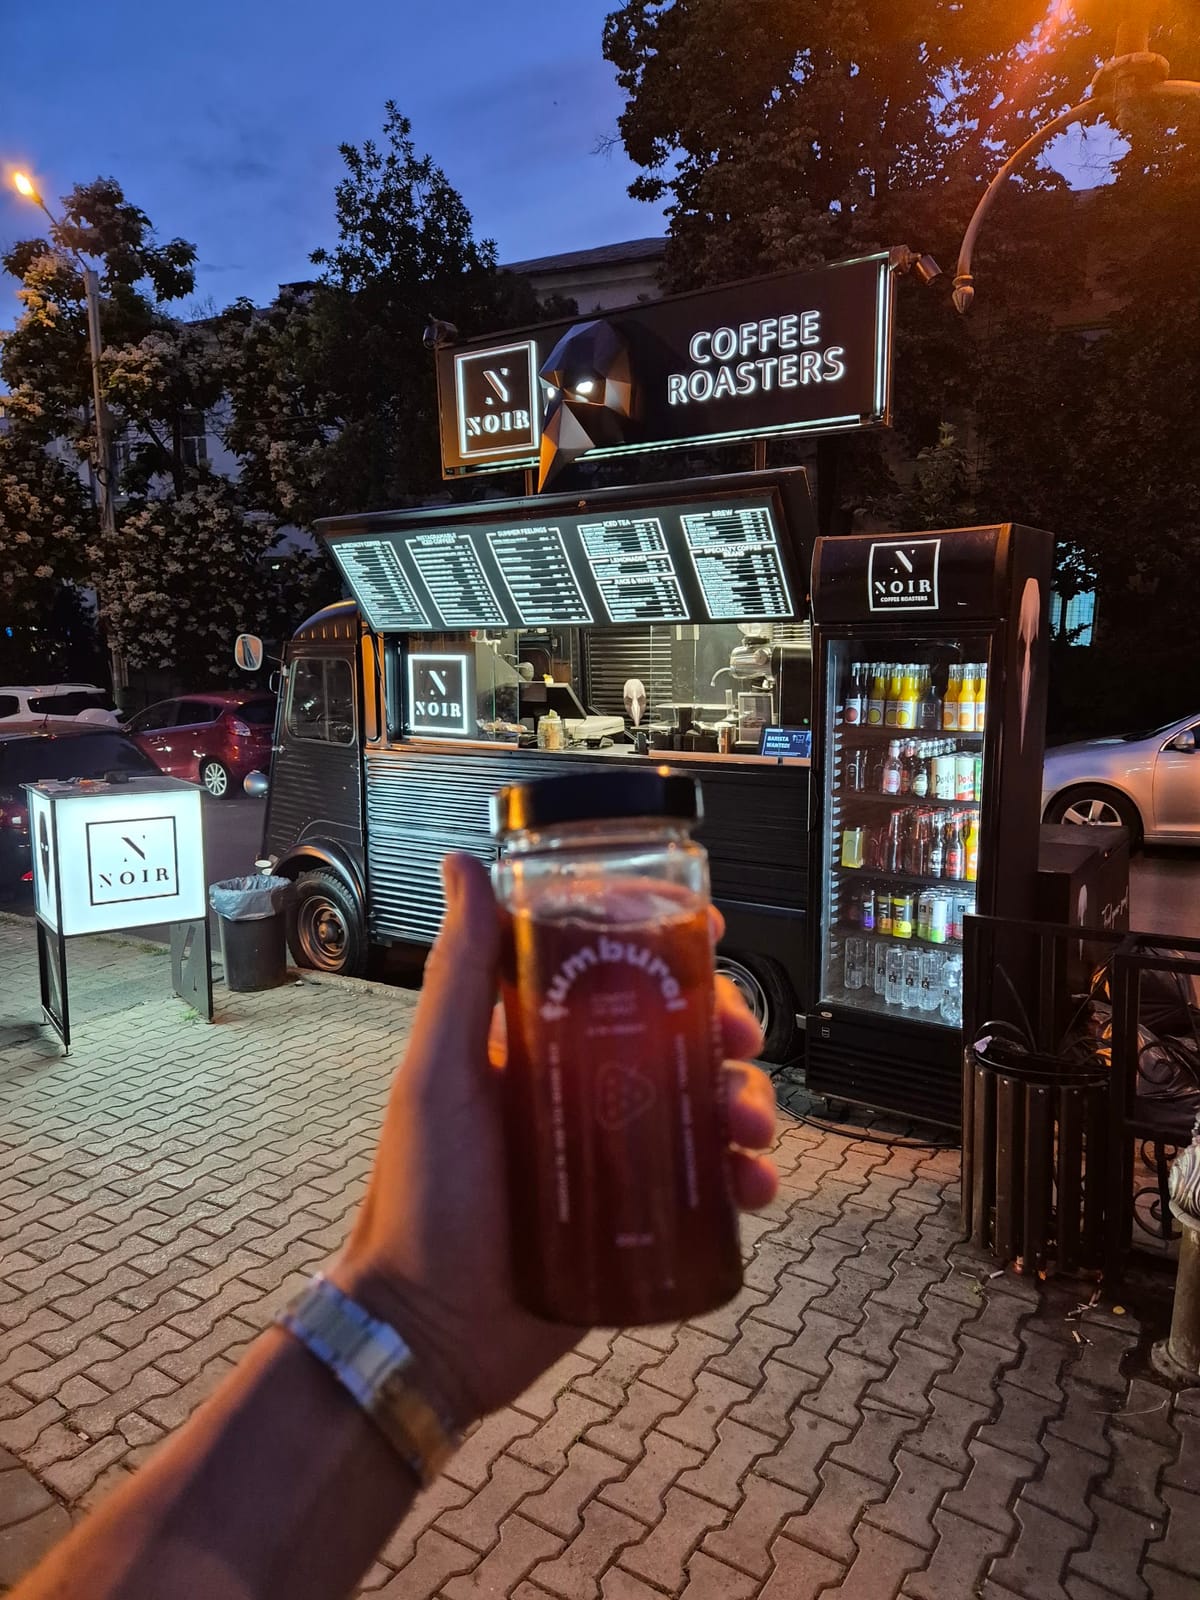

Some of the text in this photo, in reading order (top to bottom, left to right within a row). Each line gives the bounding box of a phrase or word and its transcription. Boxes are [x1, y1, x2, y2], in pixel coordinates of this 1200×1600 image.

[689, 309, 822, 365] COFFEE
[667, 345, 846, 406] ROASTERS
[465, 408, 530, 437] NOIR
[874, 579, 932, 595] NOIR
[415, 701, 462, 718] NOIR
[98, 866, 171, 889] NOIR
